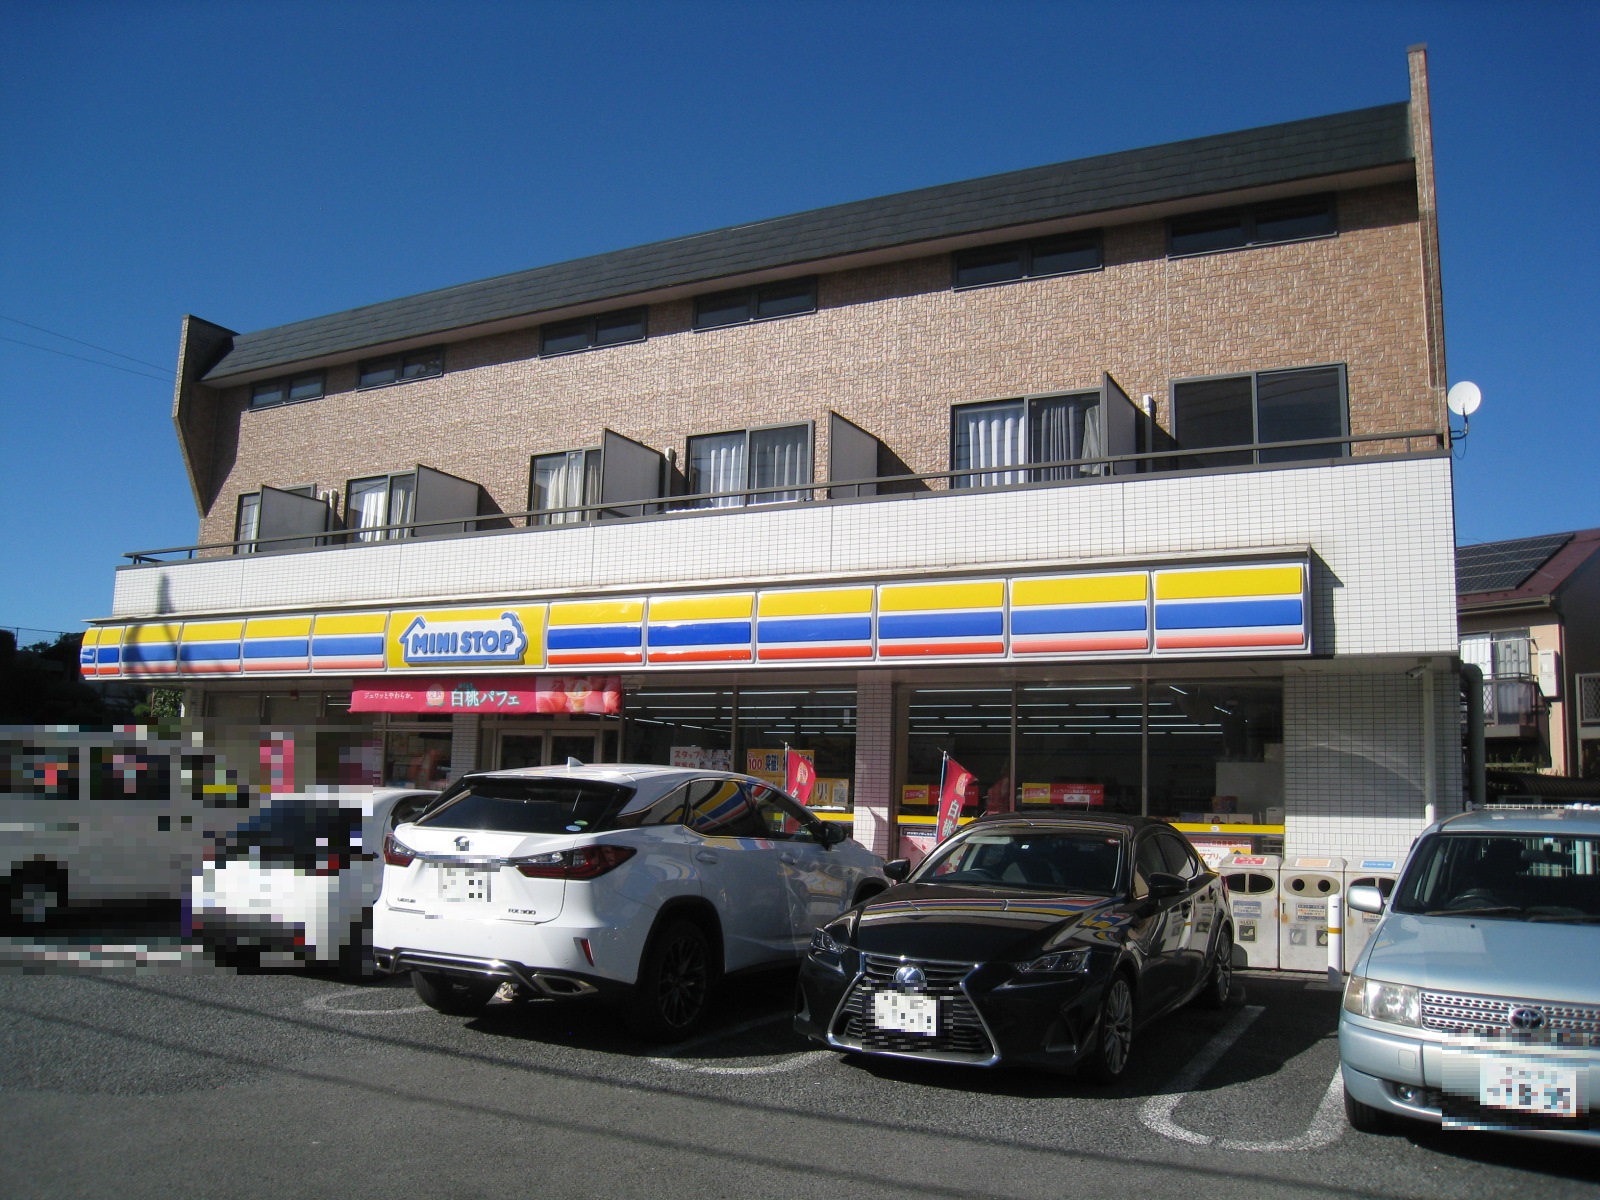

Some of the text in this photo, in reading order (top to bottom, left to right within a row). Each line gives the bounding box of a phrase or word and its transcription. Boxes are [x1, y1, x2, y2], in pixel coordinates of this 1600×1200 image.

[451, 689, 520, 706] 白桃パフェ
